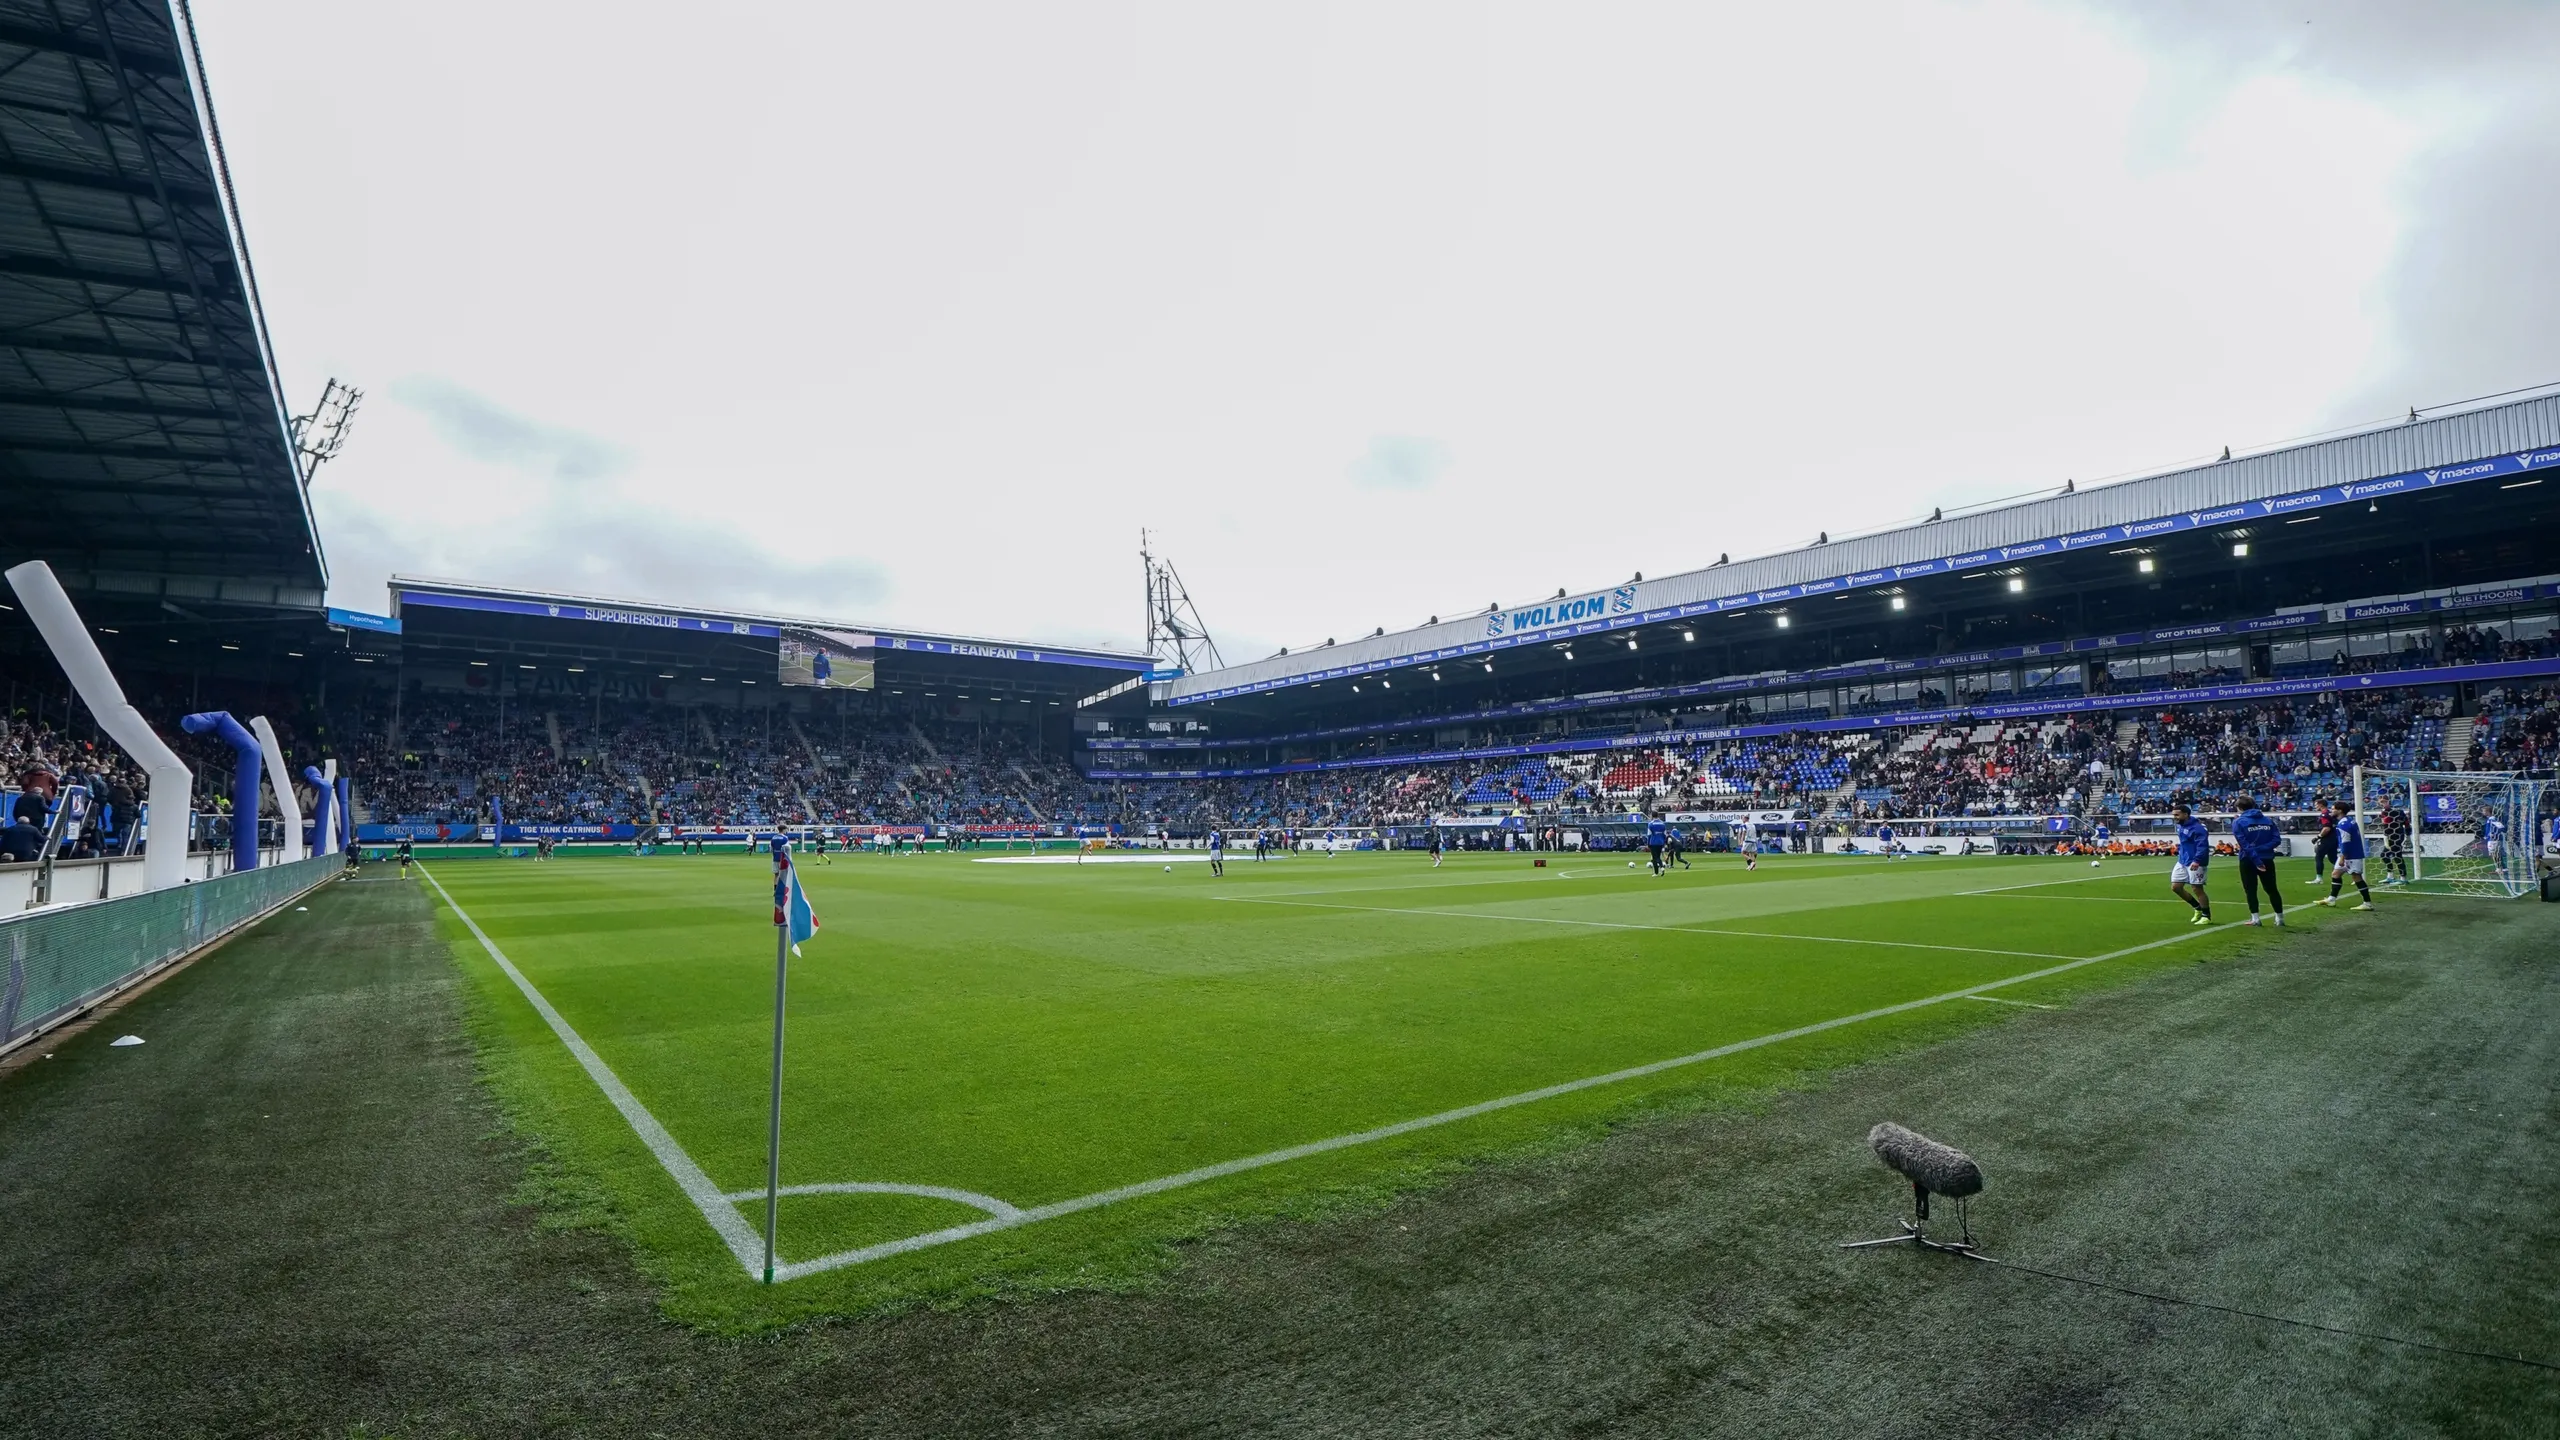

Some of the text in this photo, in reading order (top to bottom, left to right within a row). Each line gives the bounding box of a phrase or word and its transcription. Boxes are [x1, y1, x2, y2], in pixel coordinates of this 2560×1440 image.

[2535, 451, 2560, 463] ma
[2442, 464, 2494, 479] macron
[2355, 480, 2404, 495] macron
[2276, 494, 2321, 509] macron
[2202, 507, 2245, 521] macron
[2134, 520, 2174, 533] macron
[2070, 532, 2107, 545] macron
[2011, 543, 2045, 556] macron
[1955, 553, 1987, 566] macron
[1903, 563, 1933, 575] macron
[1854, 572, 1883, 583] macron
[1808, 581, 1835, 592] macron
[1765, 589, 1790, 599] macron
[2453, 589, 2523, 603] GIETHOORN
[1724, 597, 1748, 606] macron
[1513, 596, 1605, 630] WOLKOM
[1685, 604, 1708, 613] macron
[2354, 603, 2411, 617] Rabobank
[349, 614, 384, 625] Hypotheken
[585, 608, 679, 628] SUPPORTERSCLUB
[1649, 610, 1671, 620] macron
[2285, 616, 2305, 624] 2009
[1582, 623, 1602, 631] macron
[1615, 617, 1635, 626] macron
[1522, 633, 1539, 642] macron
[1551, 628, 1569, 637] macron
[2155, 631, 2172, 639] OUT
[1467, 644, 1483, 652] macron
[1494, 639, 1510, 647] macron
[951, 644, 1017, 659] FEANFAN
[1442, 649, 1457, 657] macron
[1939, 653, 1989, 665] AMSTEL BIER
[2219, 688, 2234, 697] Dyn
[2282, 682, 2311, 692] Fryske
[2136, 695, 2163, 703] daverje
[1612, 737, 1638, 746] RIEMER
[1671, 732, 1697, 742] VEDE
[1697, 730, 1731, 739] TRIBUNE
[2438, 798, 2449, 809] 8
[519, 826, 604, 834] TIGE TANK CATRINUS!
[2055, 820, 2063, 829] 7
[416, 826, 441, 835] 1920
